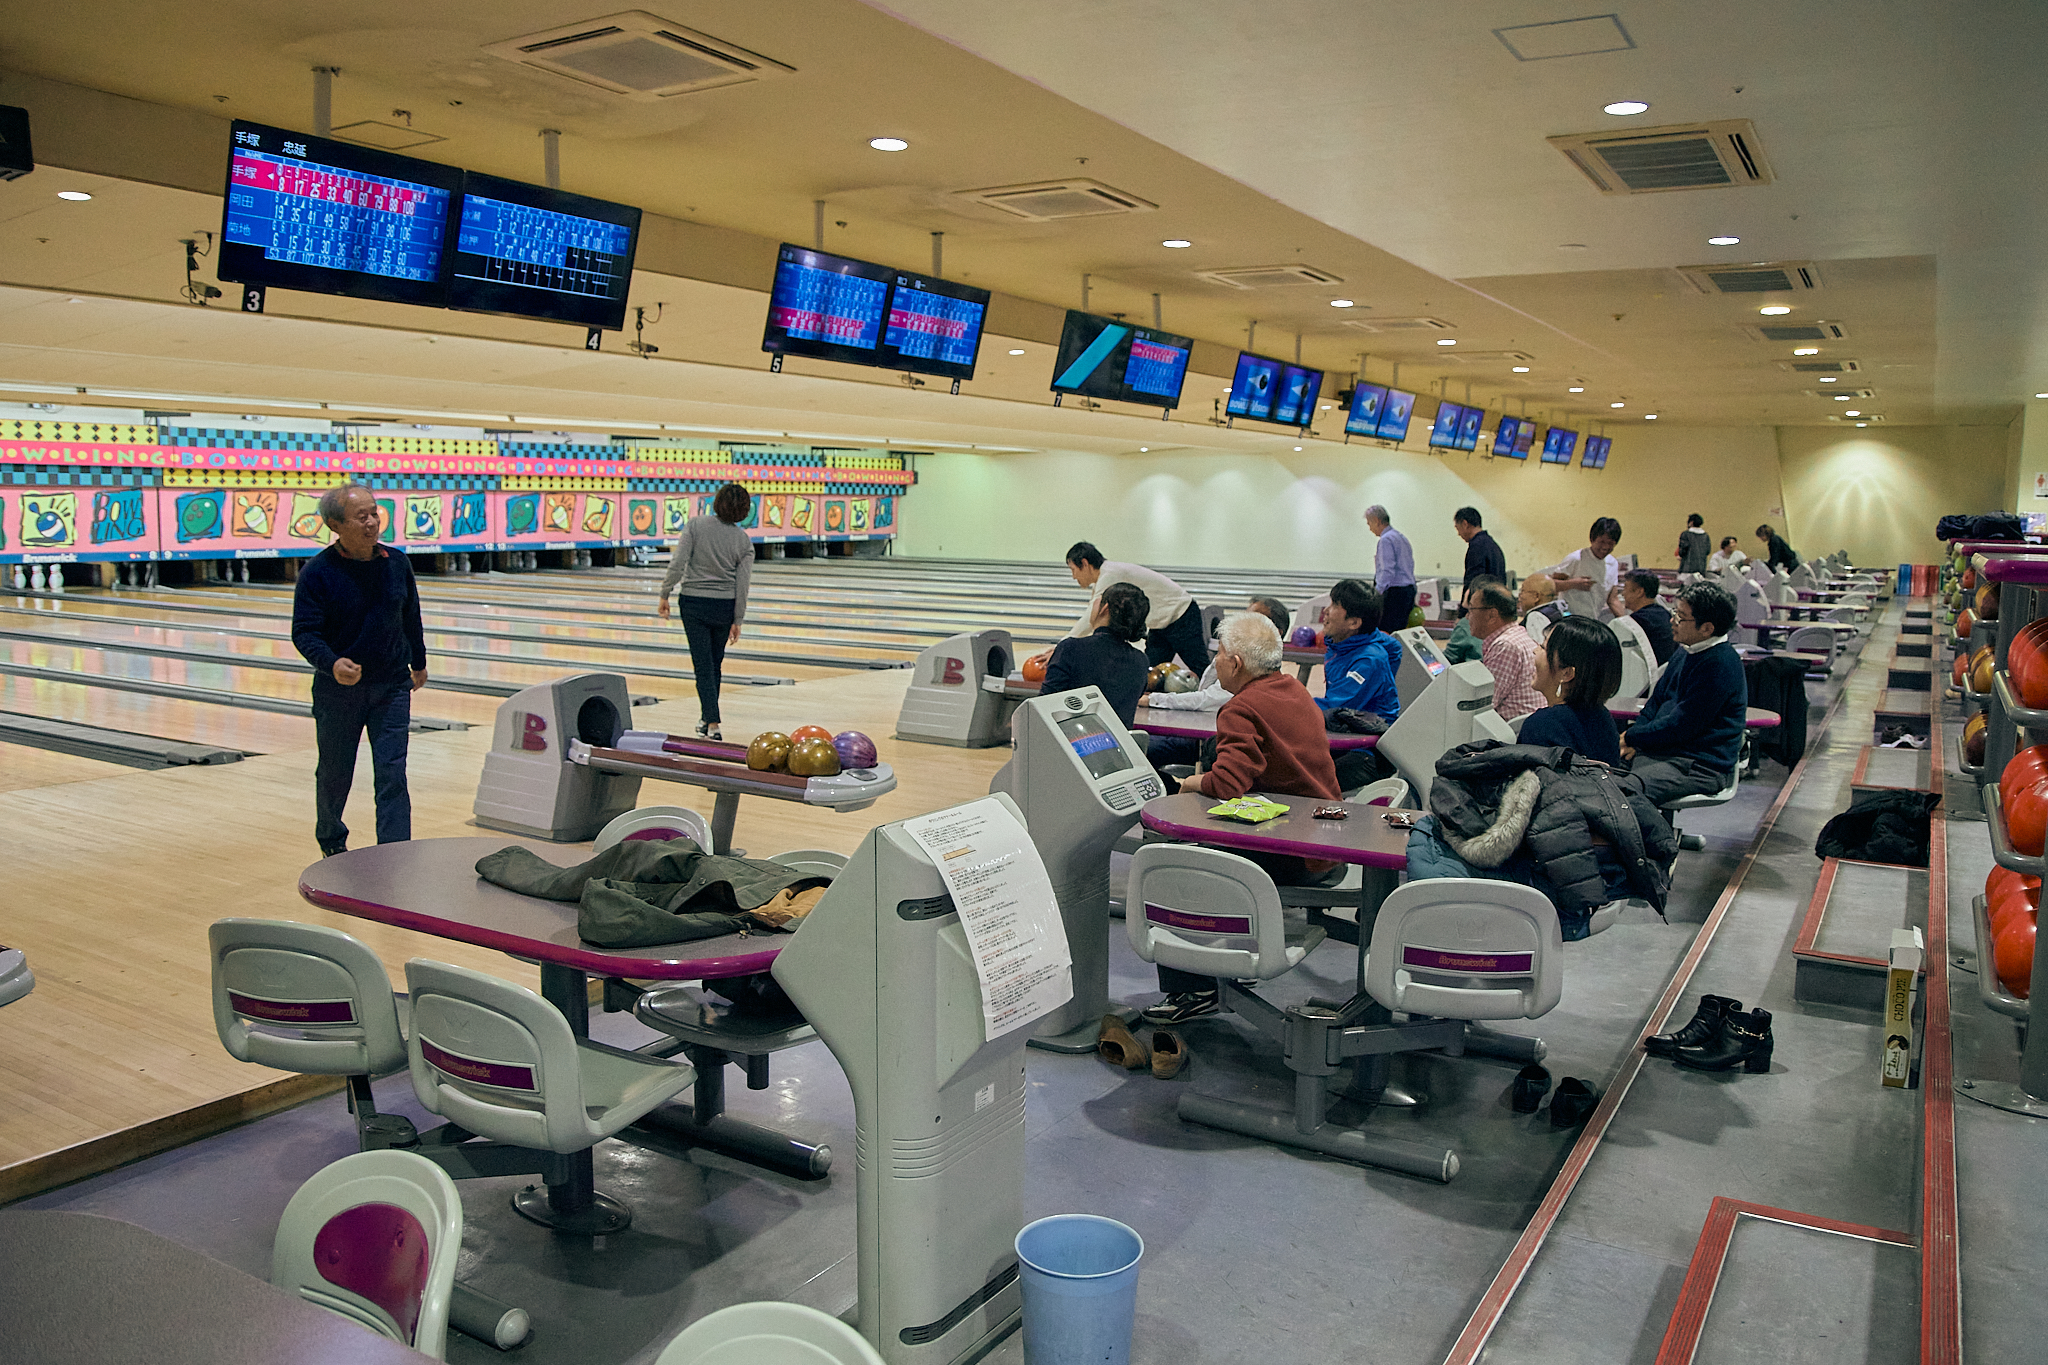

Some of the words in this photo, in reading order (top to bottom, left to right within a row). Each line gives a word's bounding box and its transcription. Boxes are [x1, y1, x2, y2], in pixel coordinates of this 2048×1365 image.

[235, 130, 260, 146] 手塚
[282, 140, 306, 156] 忠延
[232, 164, 256, 179] 手塚
[277, 177, 285, 192] 8
[293, 180, 303, 195] 17
[309, 184, 320, 198] 25
[326, 186, 336, 201] 33
[342, 190, 352, 204] 40
[373, 196, 383, 209] 79
[247, 291, 260, 311] 3
[589, 333, 599, 350] 4
[773, 357, 781, 372] 5
[953, 381, 959, 394] 6
[181, 452, 353, 470] BOWLING
[365, 457, 506, 473] BOWLING
[516, 462, 633, 476] BOWLING
[641, 465, 740, 478] BOWLING
[747, 469, 831, 481] BOWLING
[837, 472, 910, 483] BOWLING
[23, 553, 77, 563] Brunswick
[235, 549, 279, 559] Brunswick
[1896, 978, 1906, 992] PIE
[1894, 992, 1905, 1022] CHOCO
